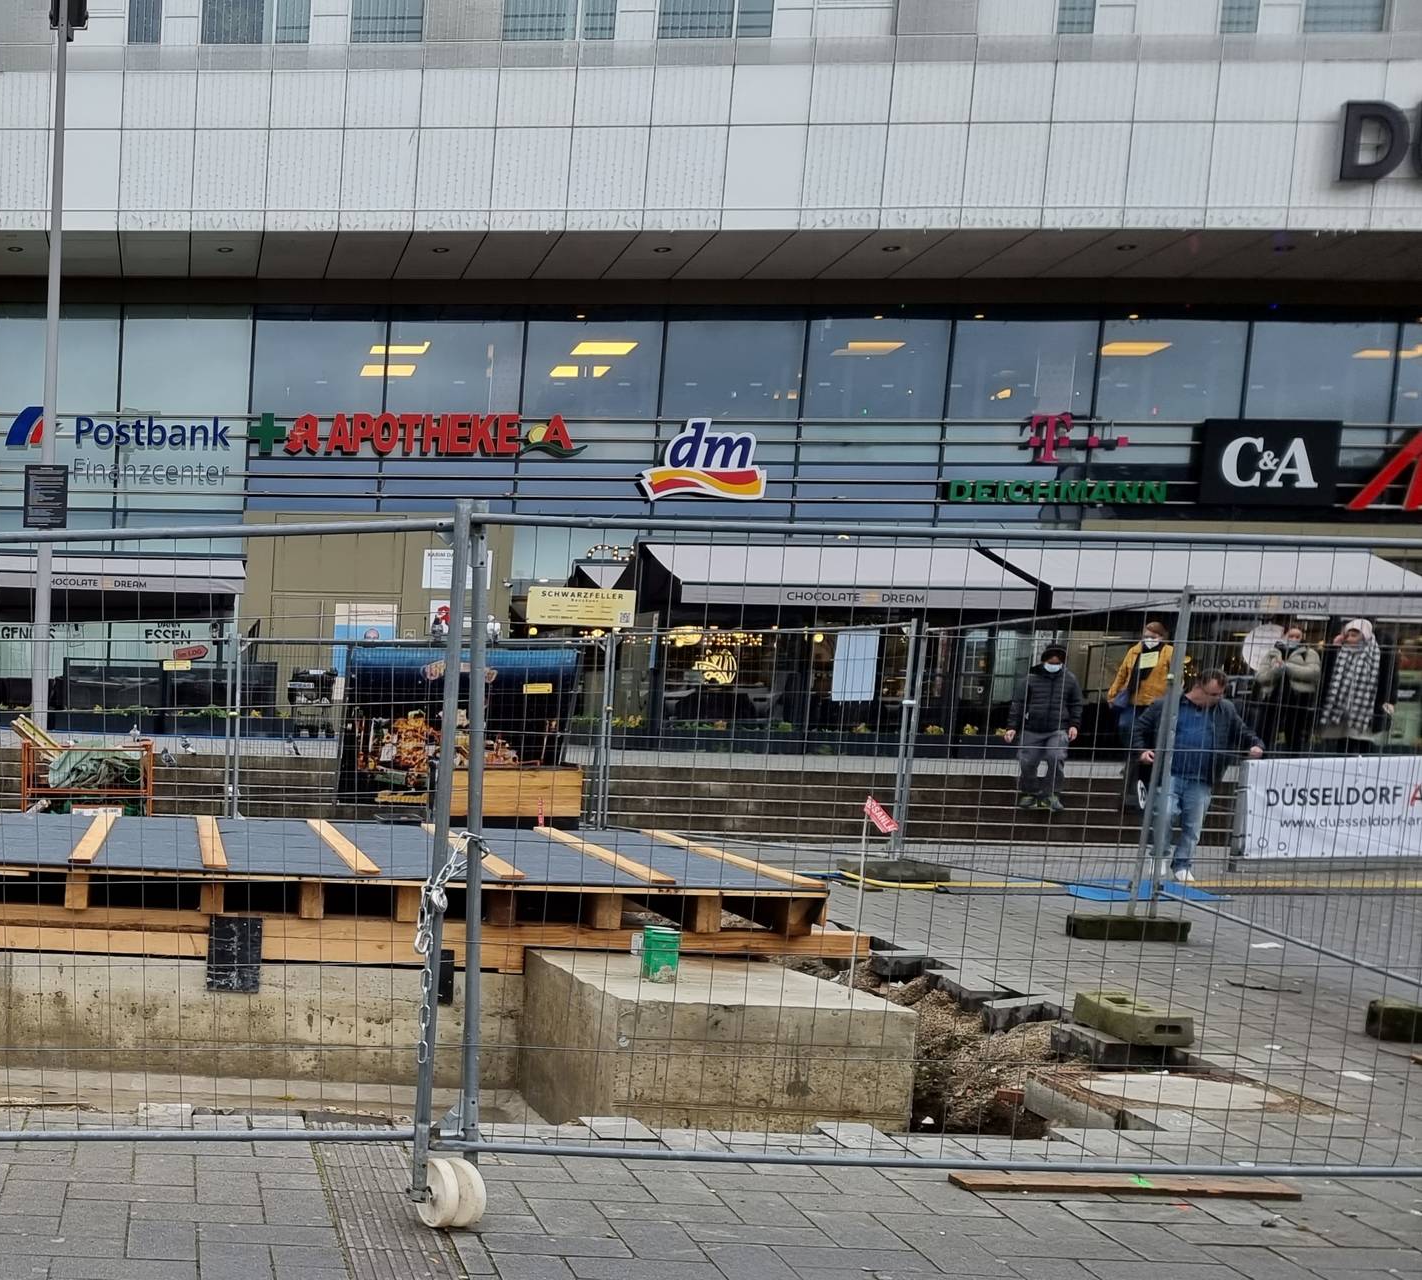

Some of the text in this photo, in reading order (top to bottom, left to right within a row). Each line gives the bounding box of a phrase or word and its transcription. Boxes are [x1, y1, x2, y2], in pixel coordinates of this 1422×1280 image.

[1339, 100, 1422, 181] D
[75, 415, 231, 448] Postbank
[327, 412, 520, 453] APOTHEKE
[669, 421, 753, 468] dm
[74, 458, 229, 485] Finanzcenter
[1221, 436, 1318, 488] C&A
[949, 480, 1168, 503] DEICHMANN
[50, 578, 146, 588] HOCOLATE DREAM
[541, 590, 624, 600] SCHWARZFELLER
[786, 591, 925, 603] CHOCOLATE DREAM
[1283, 600, 1328, 610] DREAM
[1, 626, 55, 639] GENS
[145, 629, 191, 644] ESSEN
[1266, 784, 1403, 807] DÜSSELDORF
